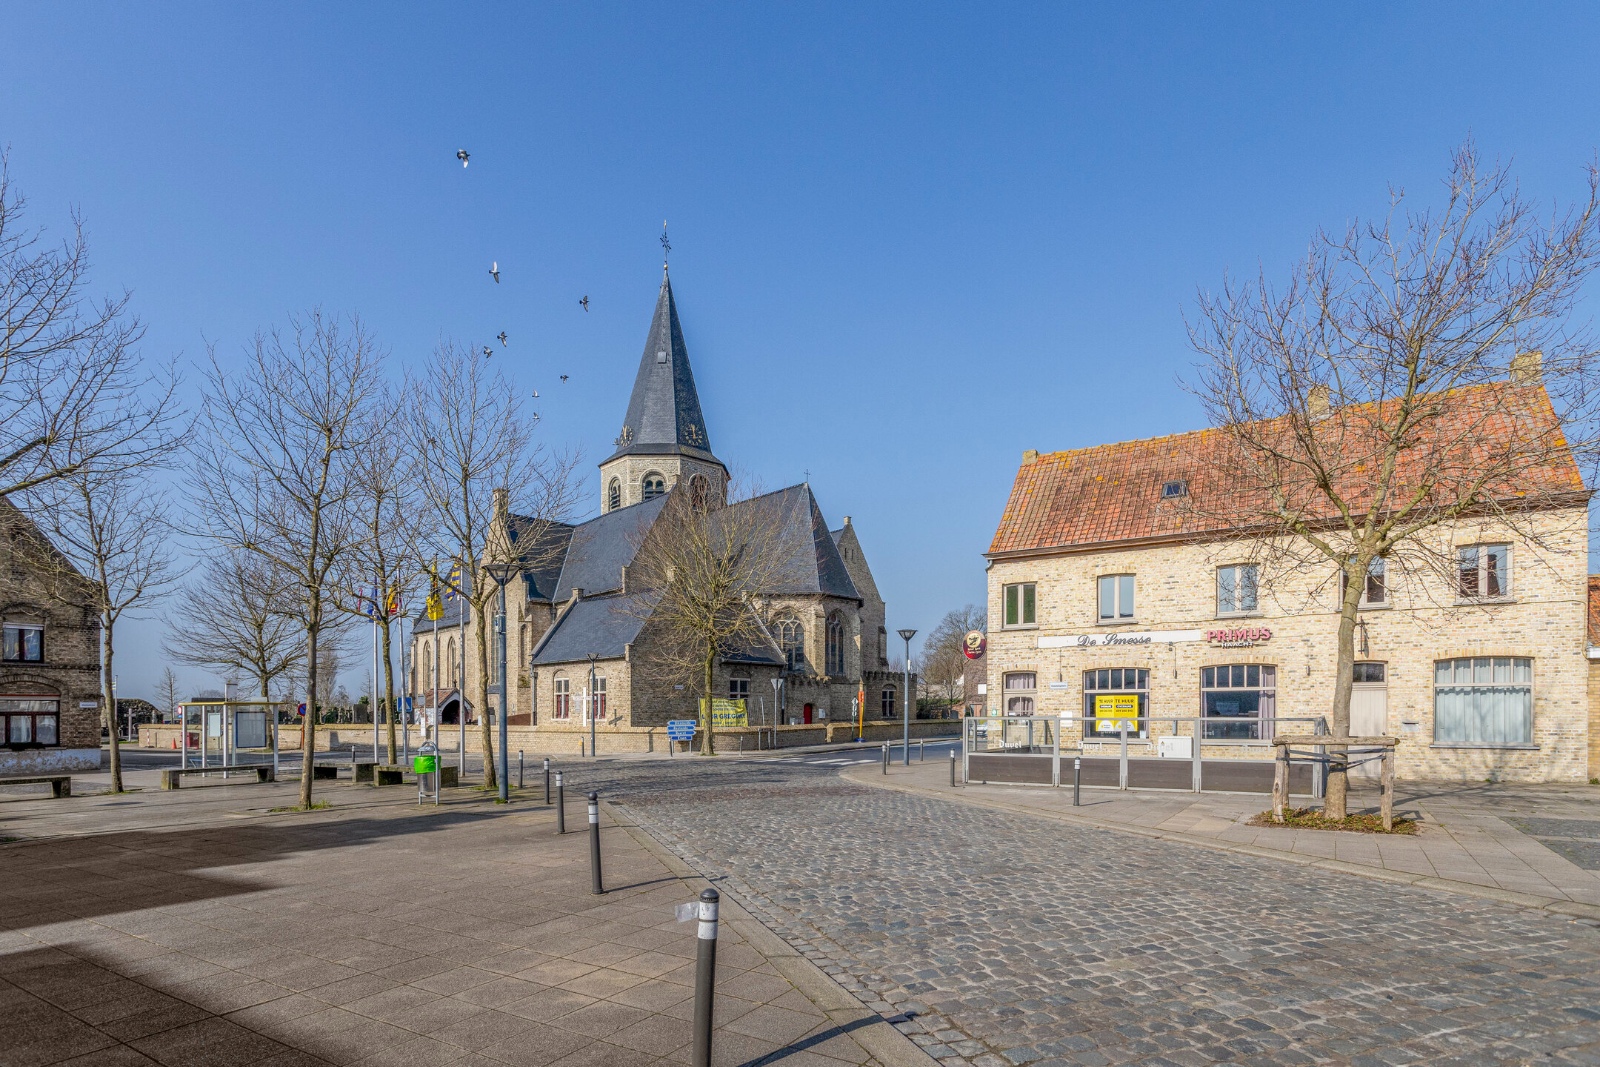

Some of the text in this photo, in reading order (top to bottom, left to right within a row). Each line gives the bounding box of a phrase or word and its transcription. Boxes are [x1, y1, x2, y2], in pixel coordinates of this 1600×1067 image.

[1207, 627, 1271, 641] PRIMUS
[1077, 634, 1096, 646] De
[998, 740, 1022, 748] Duvel
[1077, 740, 1103, 749] Duvel
